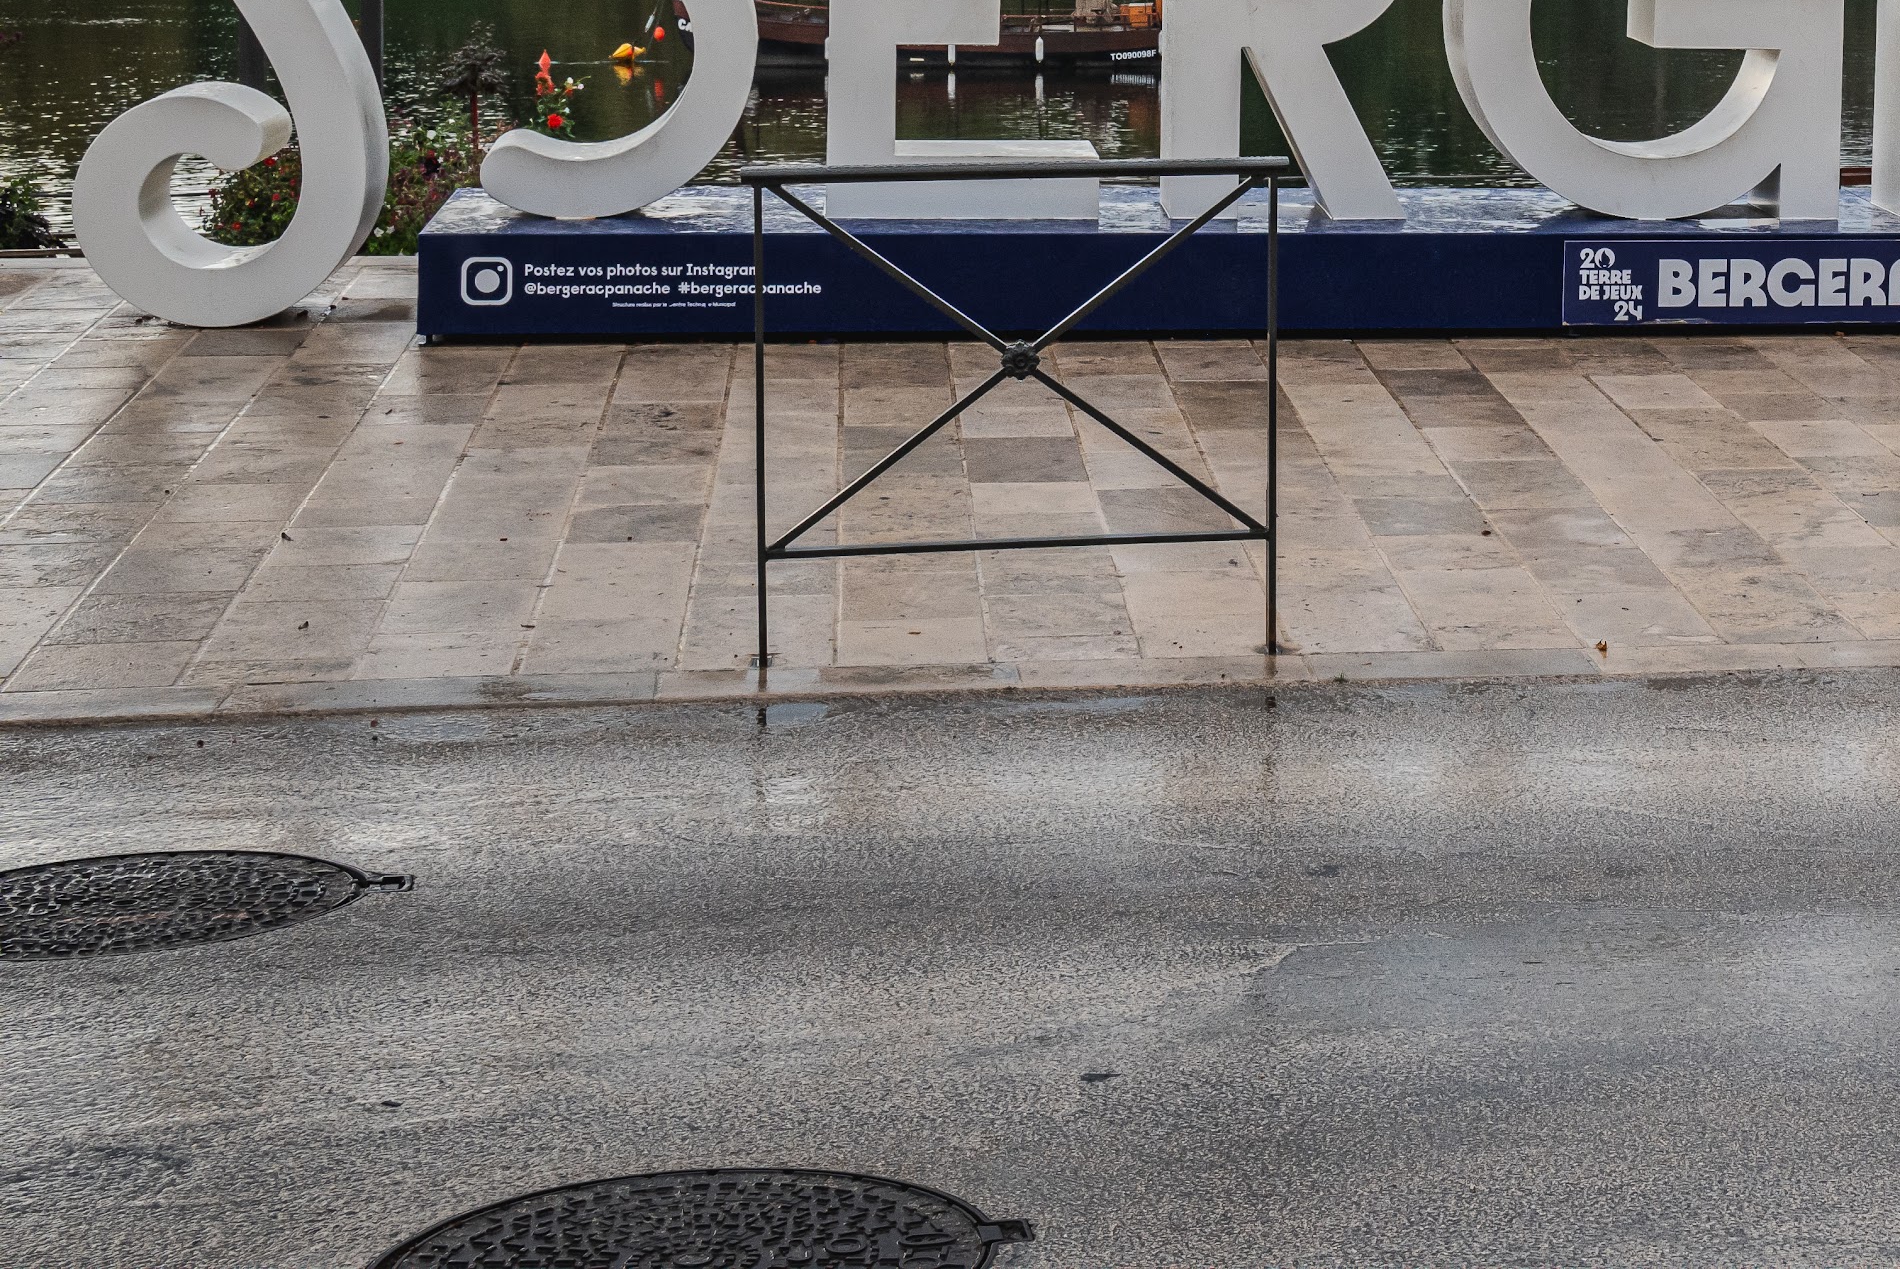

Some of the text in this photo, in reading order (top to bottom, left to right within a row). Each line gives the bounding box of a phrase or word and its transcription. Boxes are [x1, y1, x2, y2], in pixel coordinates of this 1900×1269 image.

[1110, 50, 1156, 61] TO090098F
[1580, 248, 1615, 268] 20
[524, 264, 575, 276] Postez
[578, 267, 603, 276] vos
[607, 264, 658, 280] photos
[661, 267, 683, 276] sur
[1579, 269, 1631, 284] TERRE
[524, 283, 670, 298] @bergeracpanache
[1579, 285, 1642, 300] DE JEUX
[1614, 300, 1642, 321] 24
